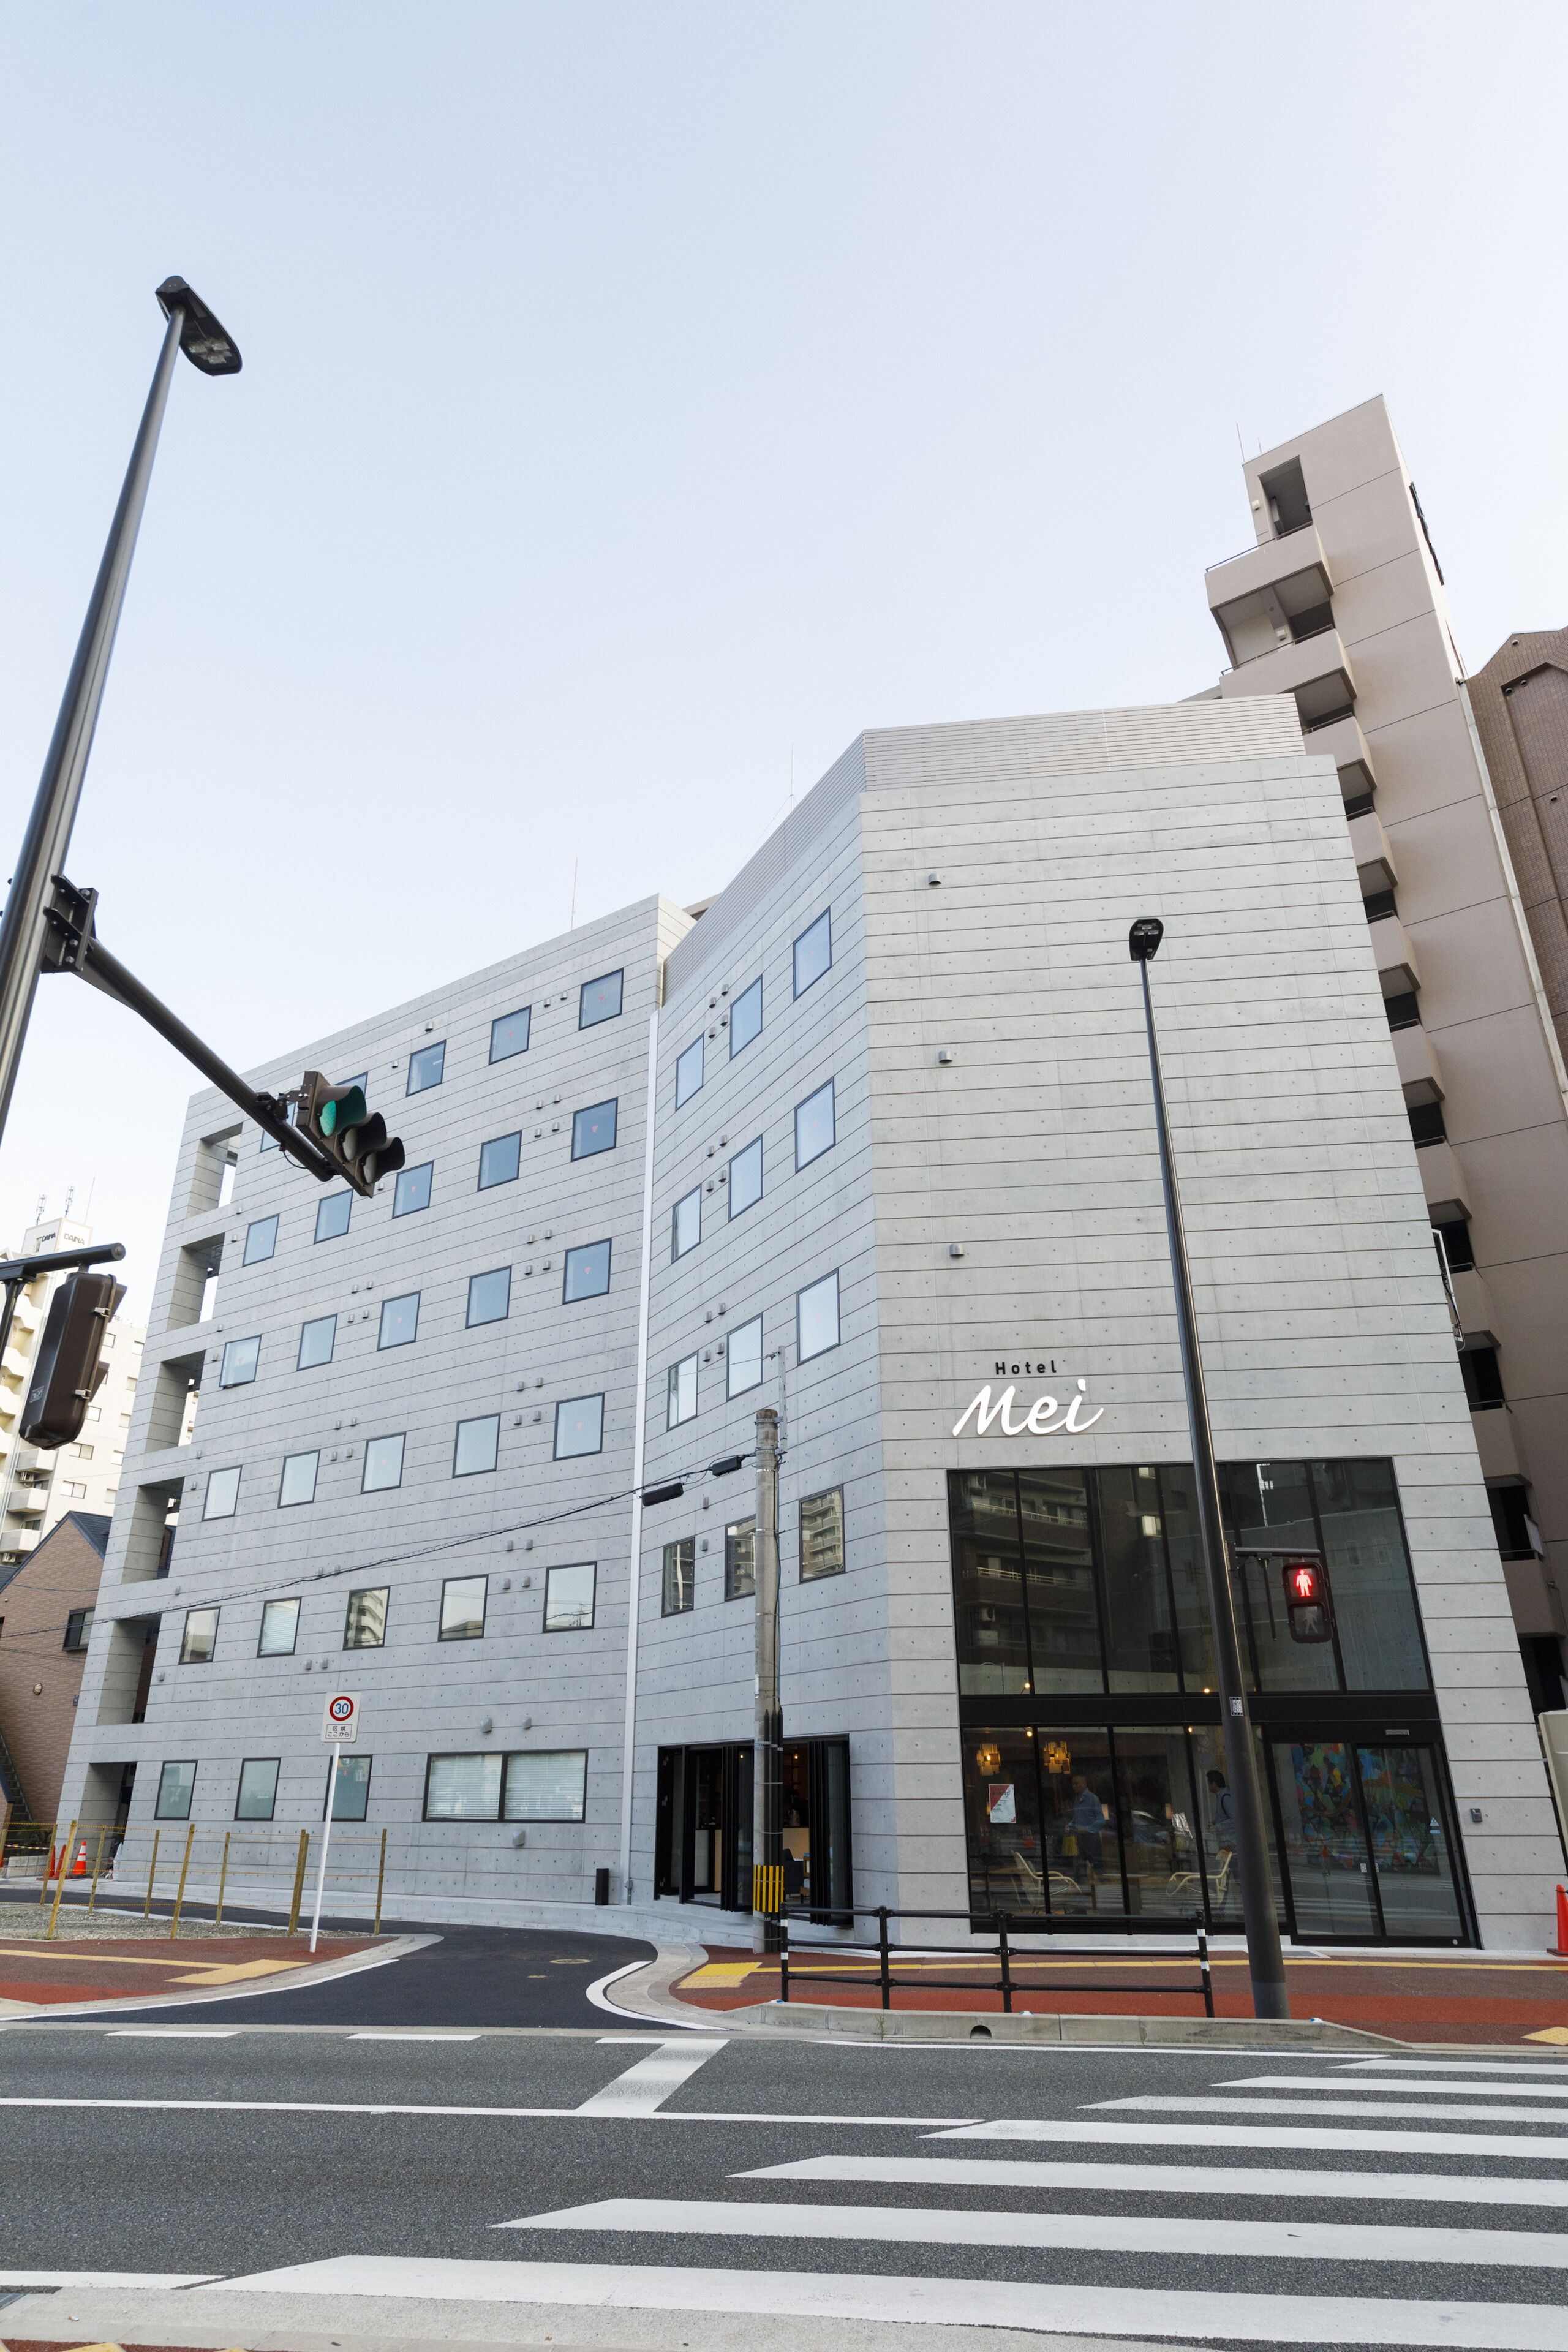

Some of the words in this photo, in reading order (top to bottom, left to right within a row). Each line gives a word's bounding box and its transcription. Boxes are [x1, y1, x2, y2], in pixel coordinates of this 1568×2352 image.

[995, 1360, 1057, 1375] Hotel
[952, 1378, 1104, 1436] Mei
[334, 1703, 349, 1714] 30
